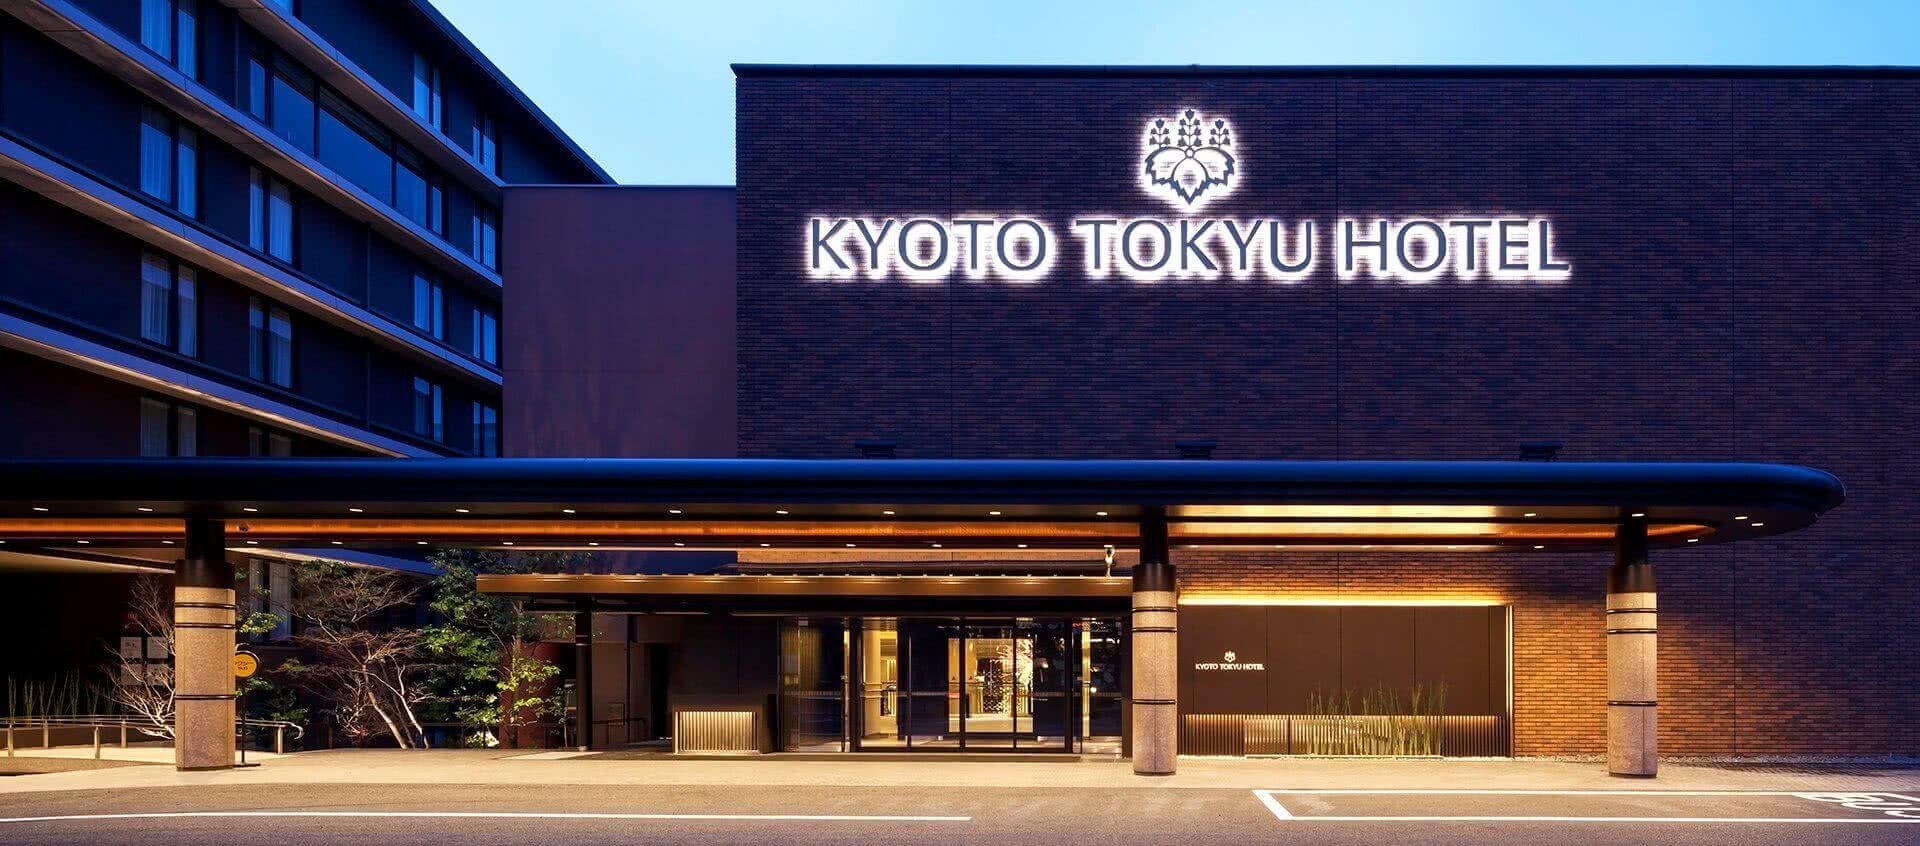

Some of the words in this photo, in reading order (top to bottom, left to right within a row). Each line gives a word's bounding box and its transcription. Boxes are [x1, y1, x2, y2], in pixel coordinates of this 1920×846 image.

[811, 218, 1047, 272] KYOTO
[1075, 218, 1313, 272] TOKYU
[1344, 218, 1571, 272] HOTEL
